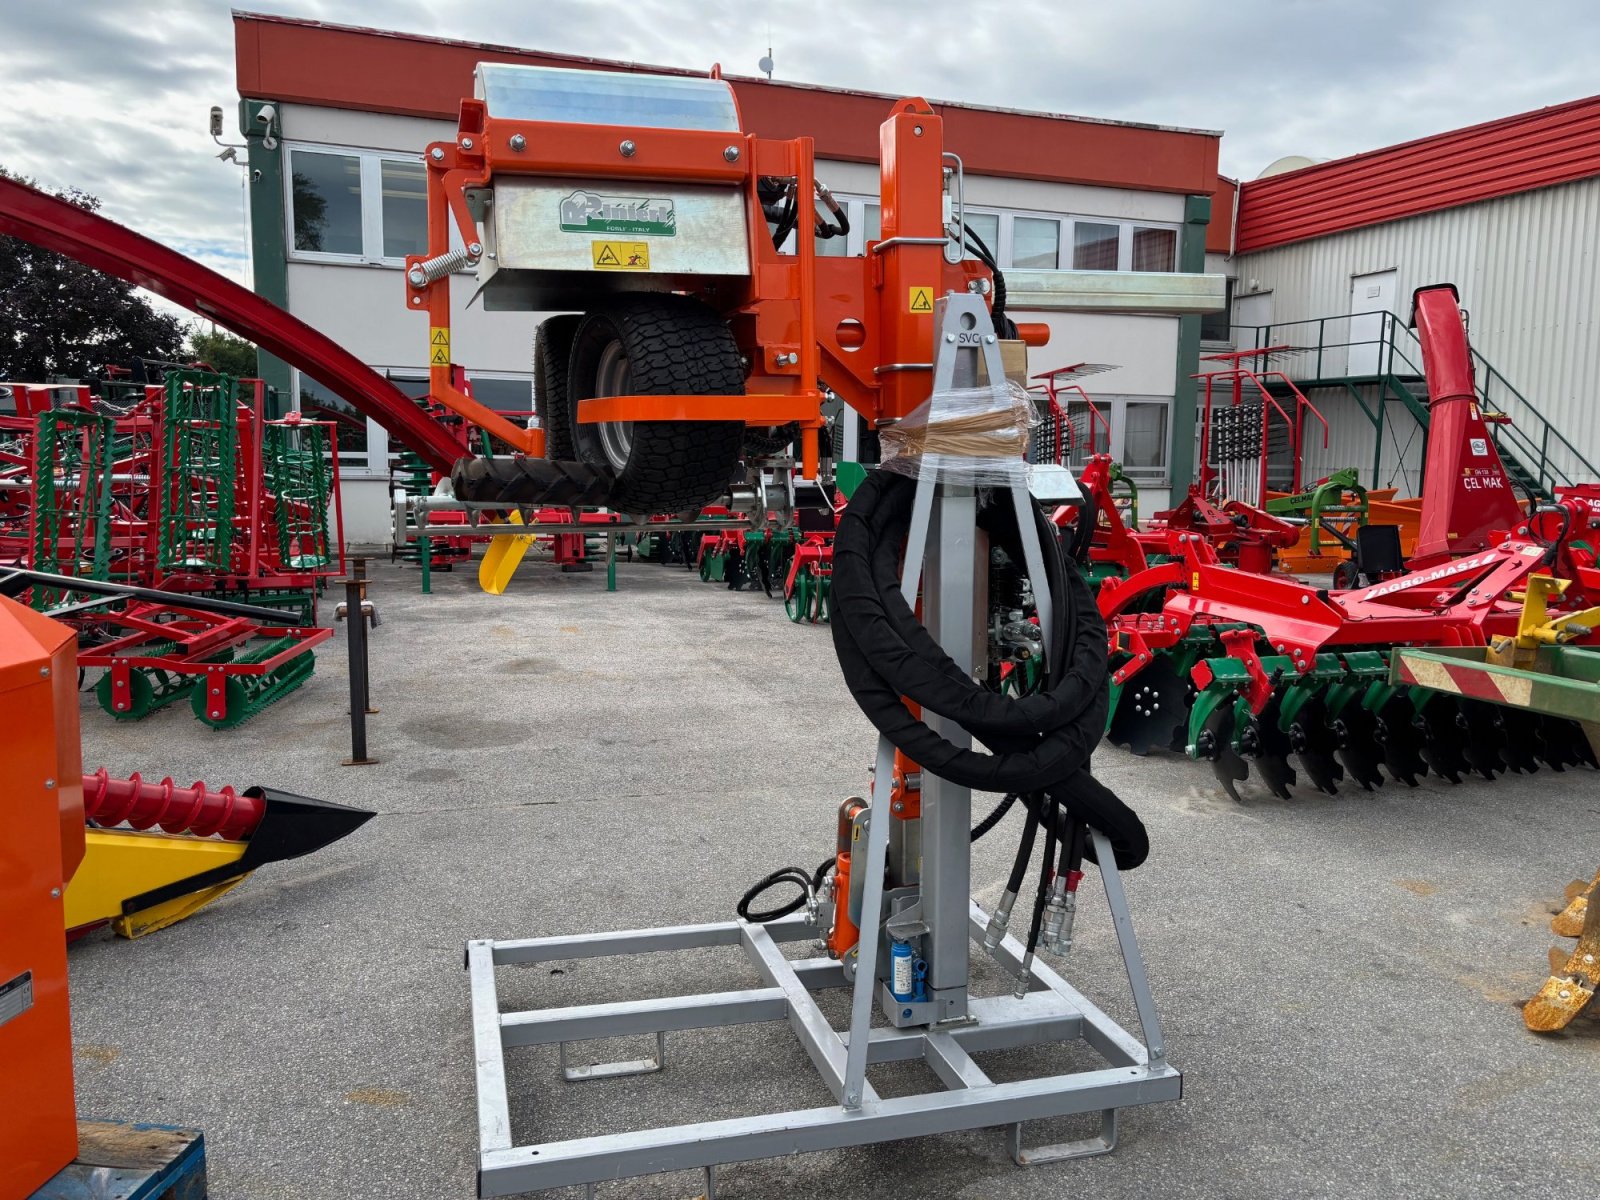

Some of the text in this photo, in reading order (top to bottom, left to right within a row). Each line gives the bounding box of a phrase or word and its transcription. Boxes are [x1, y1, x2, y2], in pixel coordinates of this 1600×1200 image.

[959, 332, 980, 344] SVC
[1482, 477, 1504, 489] MAK
[1377, 557, 1480, 597] AGRO-MASZ
